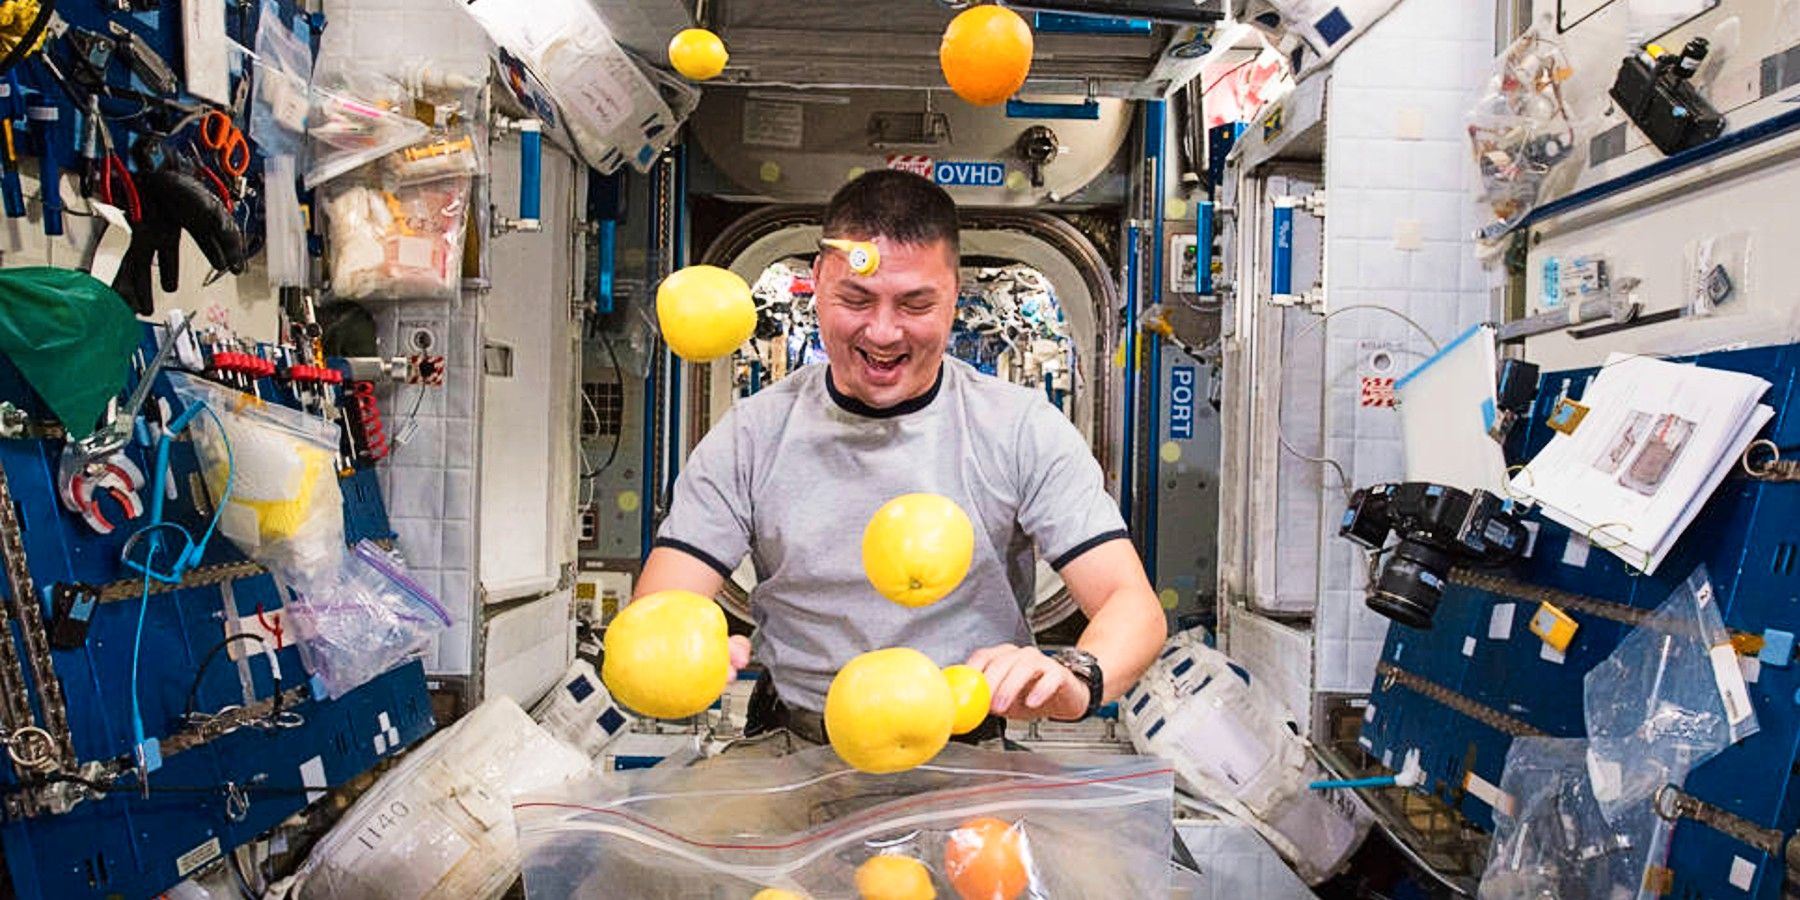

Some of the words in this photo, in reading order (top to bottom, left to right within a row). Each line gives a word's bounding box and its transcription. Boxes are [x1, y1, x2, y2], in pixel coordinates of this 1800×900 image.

[937, 164, 1003, 184] OVHD
[1172, 370, 1192, 437] PORT
[358, 801, 409, 849] 1140
